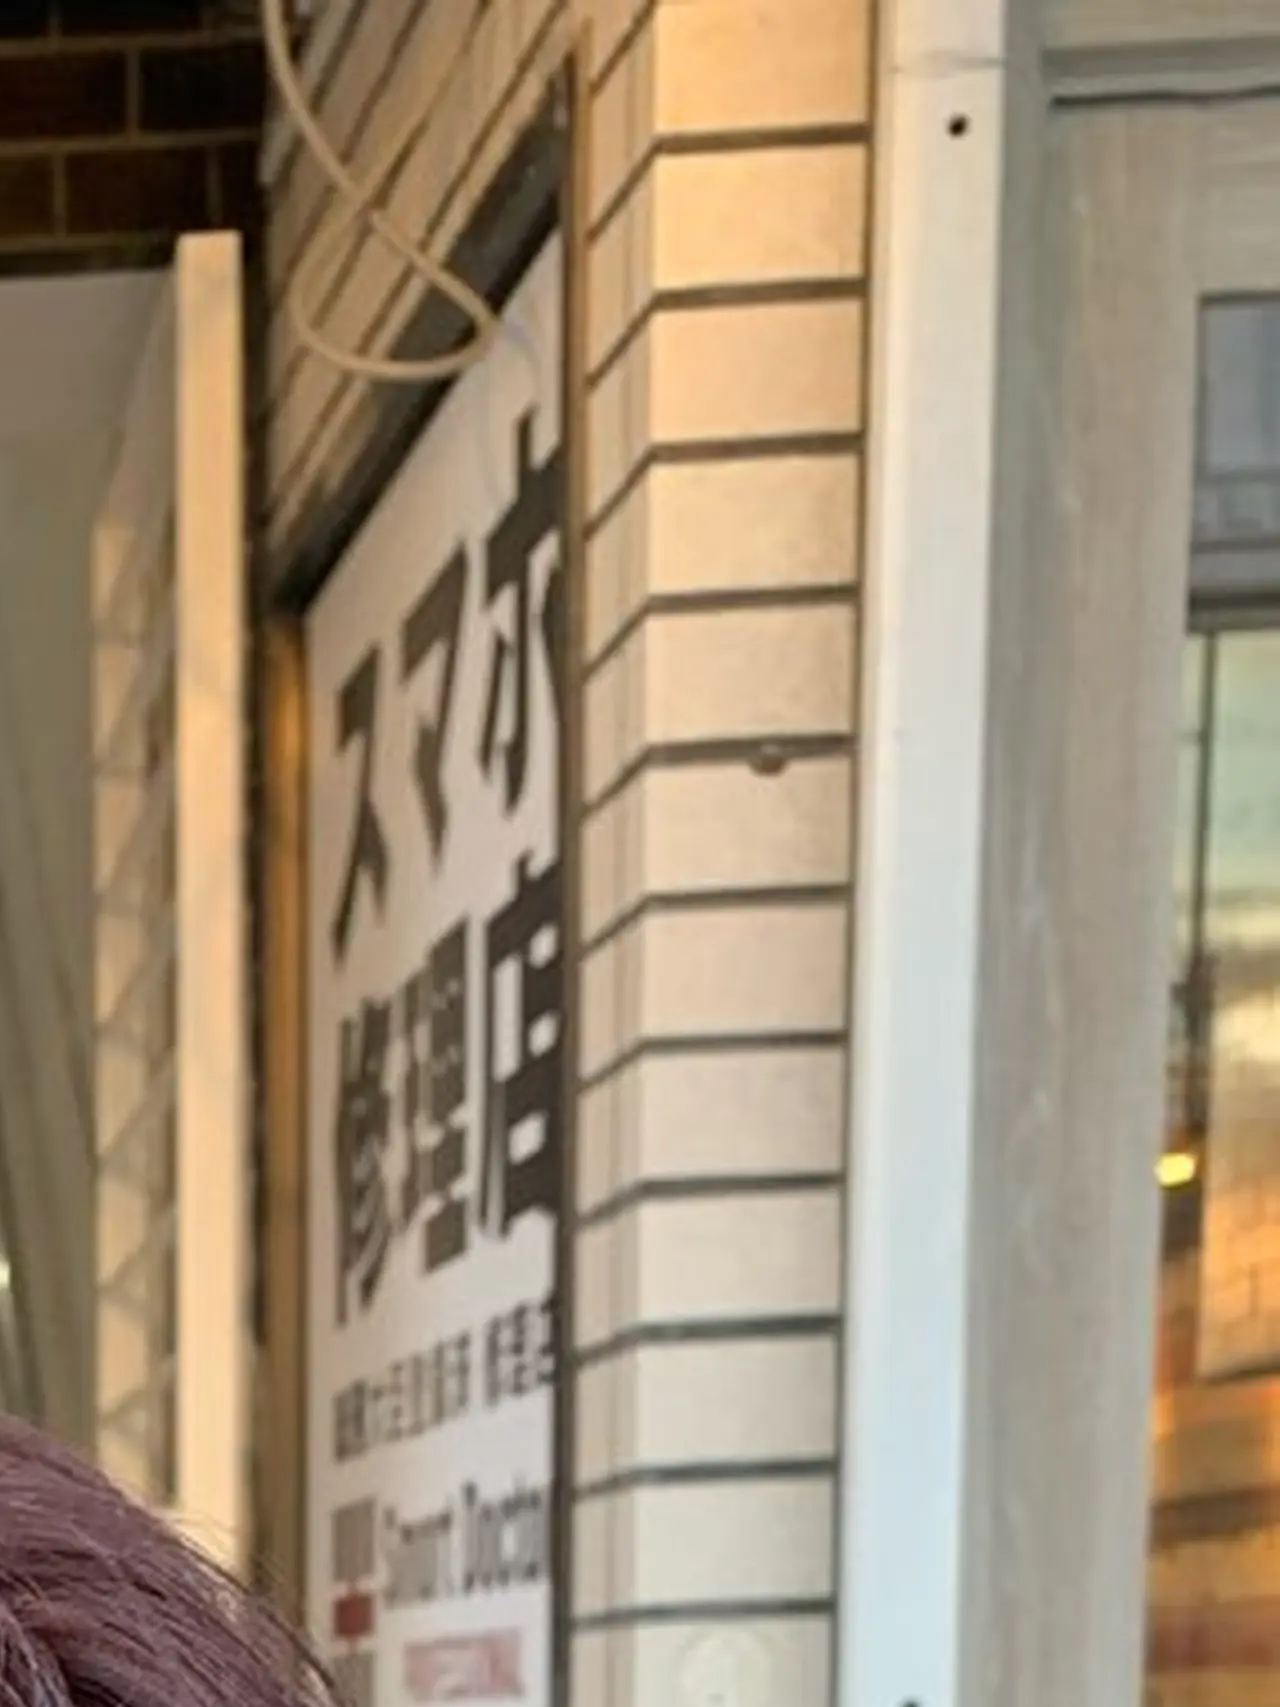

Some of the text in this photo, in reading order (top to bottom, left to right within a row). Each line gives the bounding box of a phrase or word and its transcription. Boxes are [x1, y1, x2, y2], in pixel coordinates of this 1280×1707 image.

[333, 405, 564, 970] スマホ
[333, 848, 564, 1328] 修理店
